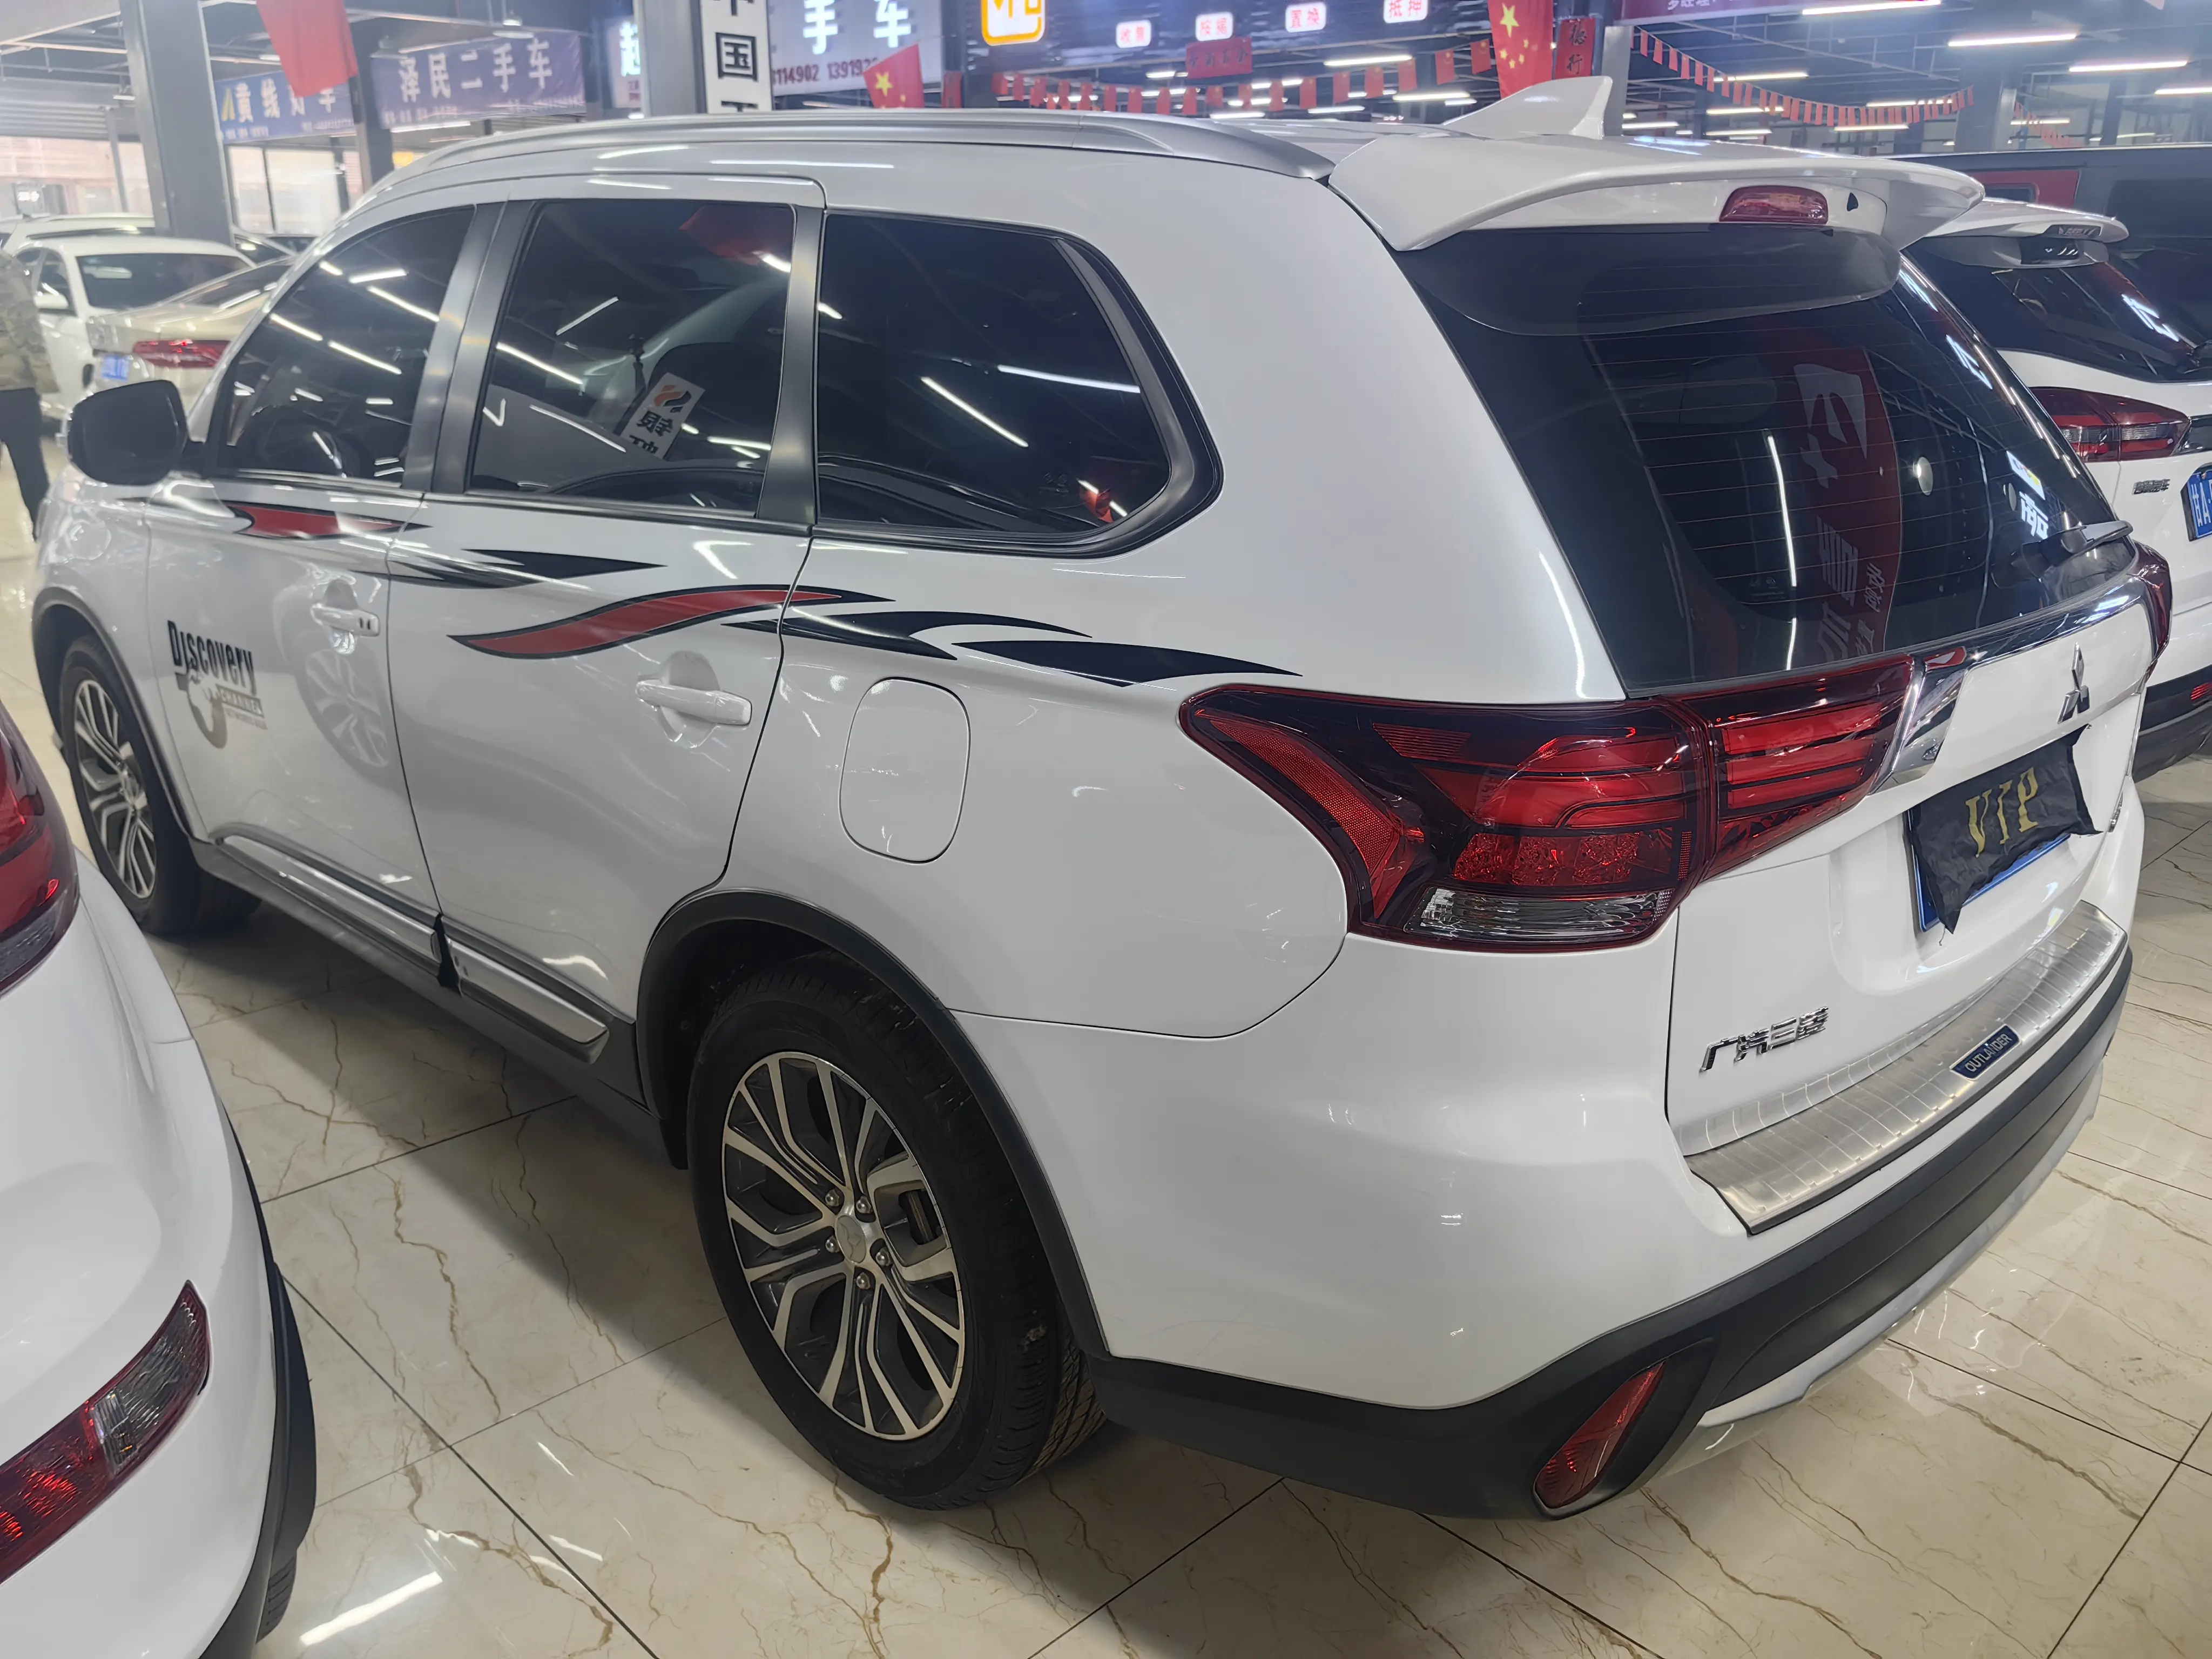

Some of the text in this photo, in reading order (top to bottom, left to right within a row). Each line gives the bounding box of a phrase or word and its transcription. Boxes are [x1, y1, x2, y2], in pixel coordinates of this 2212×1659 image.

[398, 37, 552, 103] 泽民二手车
[1965, 767, 2038, 858] VIP
[1699, 1006, 1829, 1073] 广汽三菱
[1964, 1034, 2013, 1072] OUTLANDER
